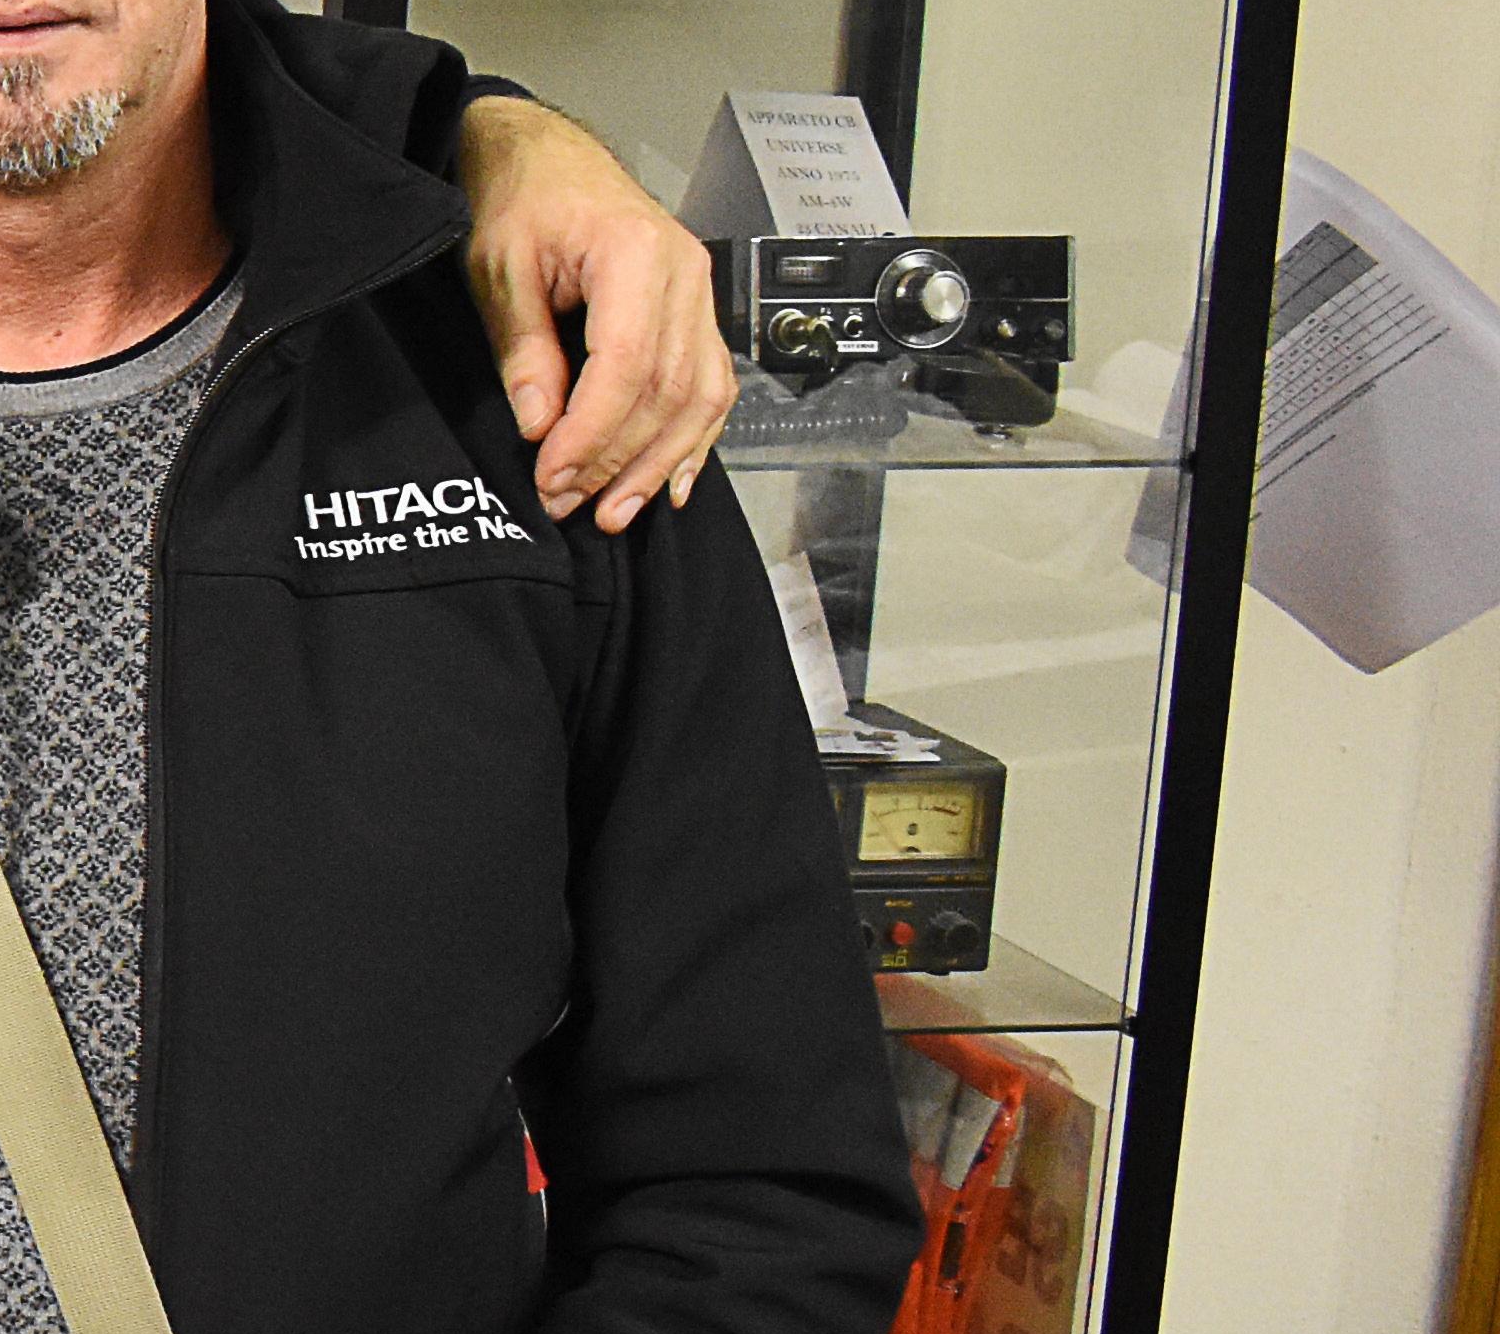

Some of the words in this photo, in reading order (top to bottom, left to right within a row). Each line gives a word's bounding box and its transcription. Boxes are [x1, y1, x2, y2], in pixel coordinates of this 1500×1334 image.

[746, 111, 832, 129] APPARATO
[835, 114, 858, 129] CB
[766, 139, 848, 155] UNIVERSE
[776, 166, 823, 181] ANNO
[304, 475, 509, 530] HITACH
[294, 531, 408, 561] Inspire
[412, 521, 470, 548] the
[473, 515, 536, 546] Ne
